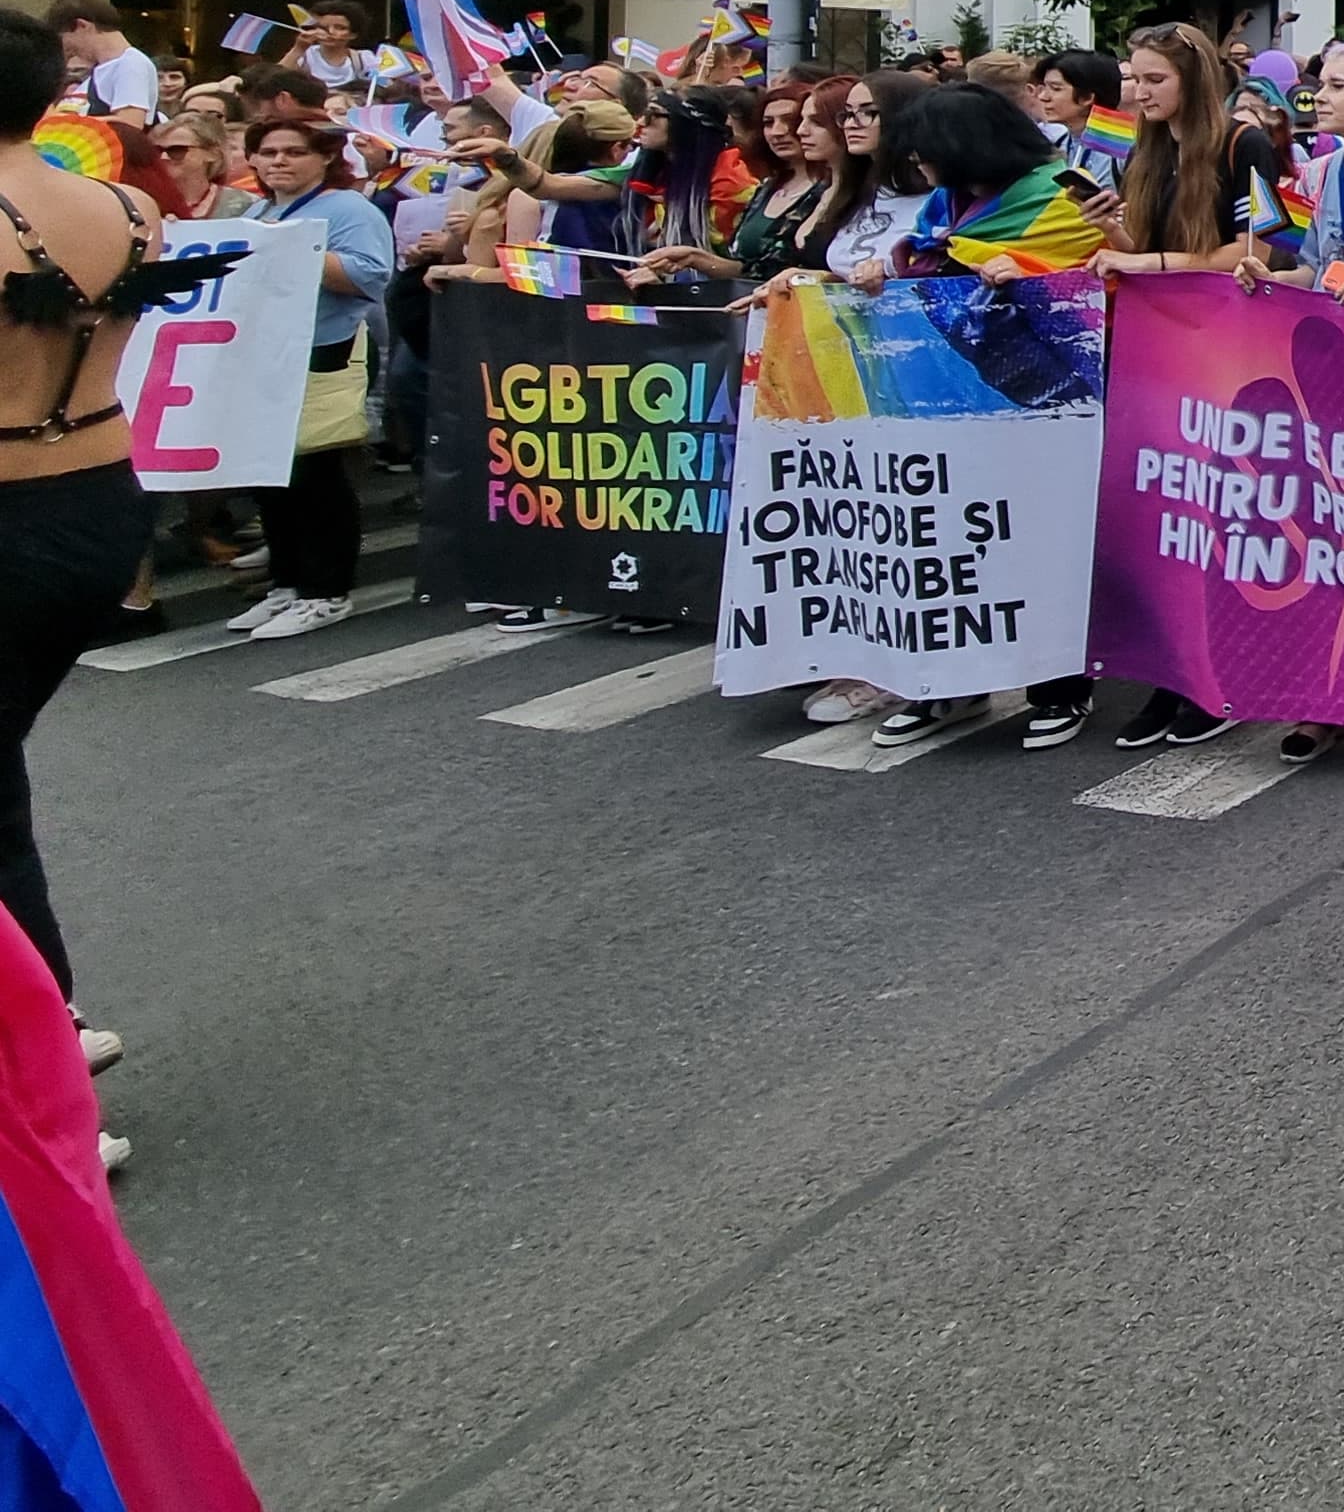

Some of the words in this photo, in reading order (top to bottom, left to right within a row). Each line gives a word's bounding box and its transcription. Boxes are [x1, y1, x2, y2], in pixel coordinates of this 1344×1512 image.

[1179, 396, 1294, 461] UNDE
[1303, 420, 1323, 469] E
[770, 438, 864, 492] FĂRĂ
[873, 451, 949, 496] LEGI
[1135, 447, 1300, 522] PENTRU
[488, 479, 564, 529] FOR
[962, 499, 1012, 560] ȘI
[751, 545, 981, 601] TRANSFOBE
[1158, 511, 1216, 574] HIV
[1223, 521, 1288, 584] ÎN
[800, 594, 1027, 654] PARLAMENT
